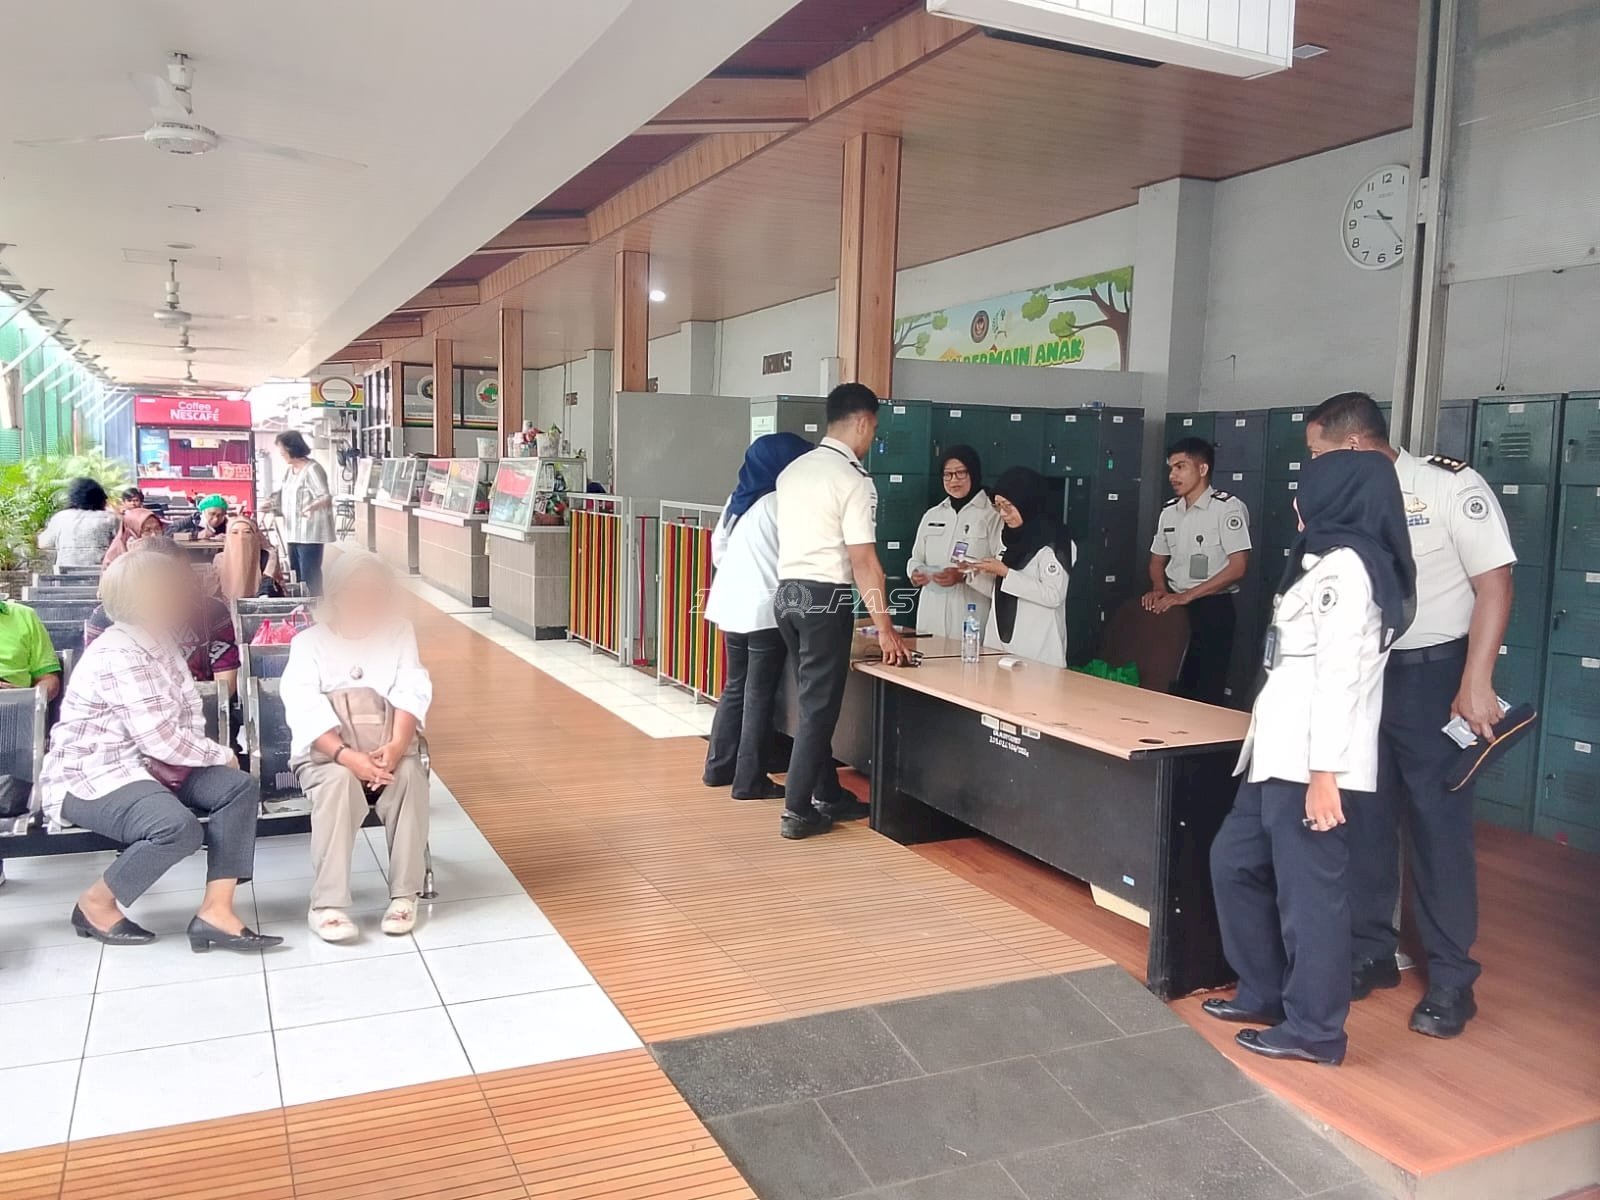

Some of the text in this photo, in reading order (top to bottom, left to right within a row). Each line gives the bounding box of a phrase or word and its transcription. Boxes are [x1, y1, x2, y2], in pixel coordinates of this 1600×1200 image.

[1382, 172, 1392, 184] 12
[1367, 182, 1374, 192] 11
[1353, 200, 1363, 210] 10
[1349, 219, 1357, 230] 9
[1352, 237, 1360, 248] 8
[1394, 244, 1403, 255] 5
[1361, 251, 1369, 261] 7
[1377, 253, 1386, 263] 6
[1036, 337, 1083, 365] ANAK
[178, 401, 211, 410] Coffee
[170, 407, 219, 421] NESCAFÉ
